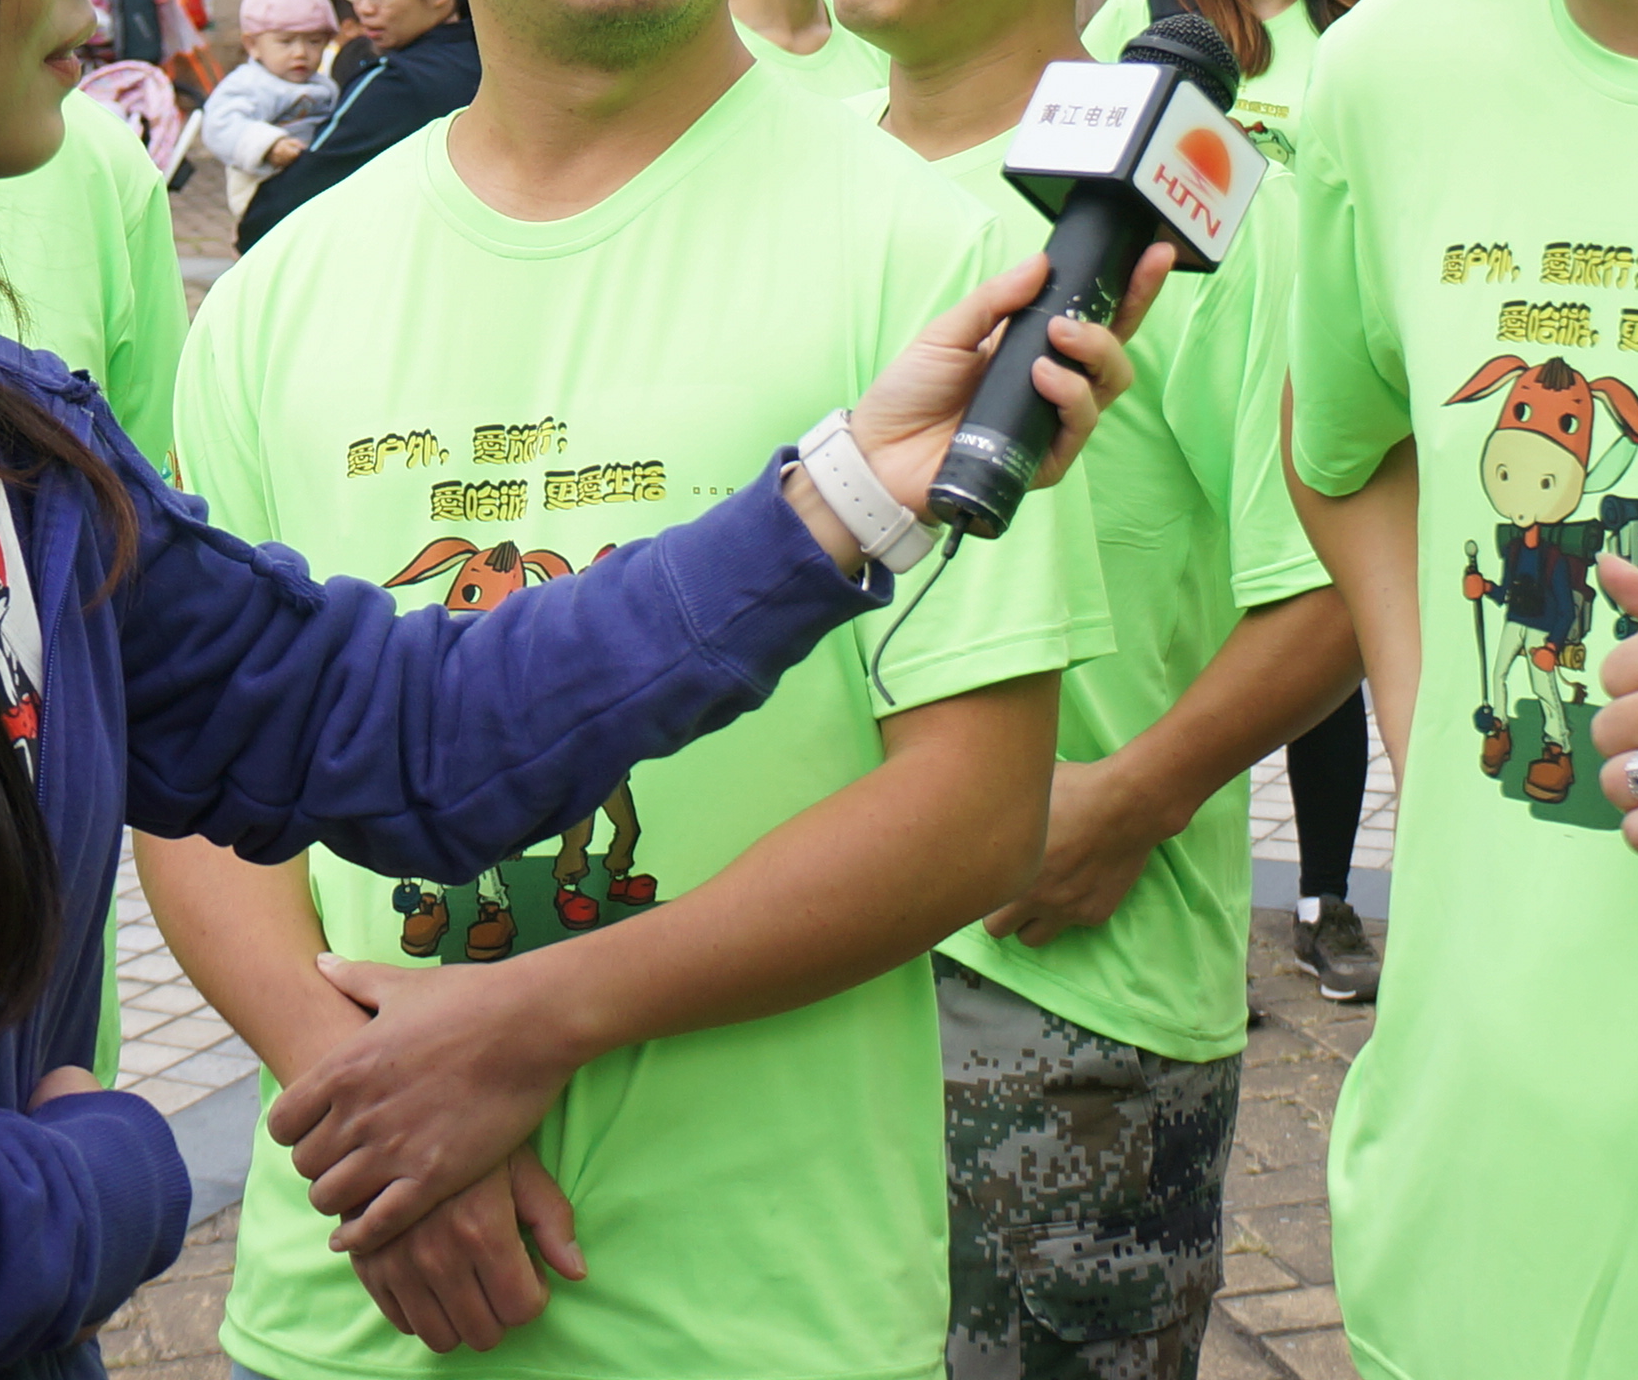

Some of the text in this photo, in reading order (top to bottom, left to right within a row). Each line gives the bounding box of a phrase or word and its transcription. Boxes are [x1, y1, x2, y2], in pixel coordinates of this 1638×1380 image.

[1038, 103, 1129, 128] 黄江电视
[1152, 163, 1222, 239] HJTV
[951, 432, 990, 450] ONY
